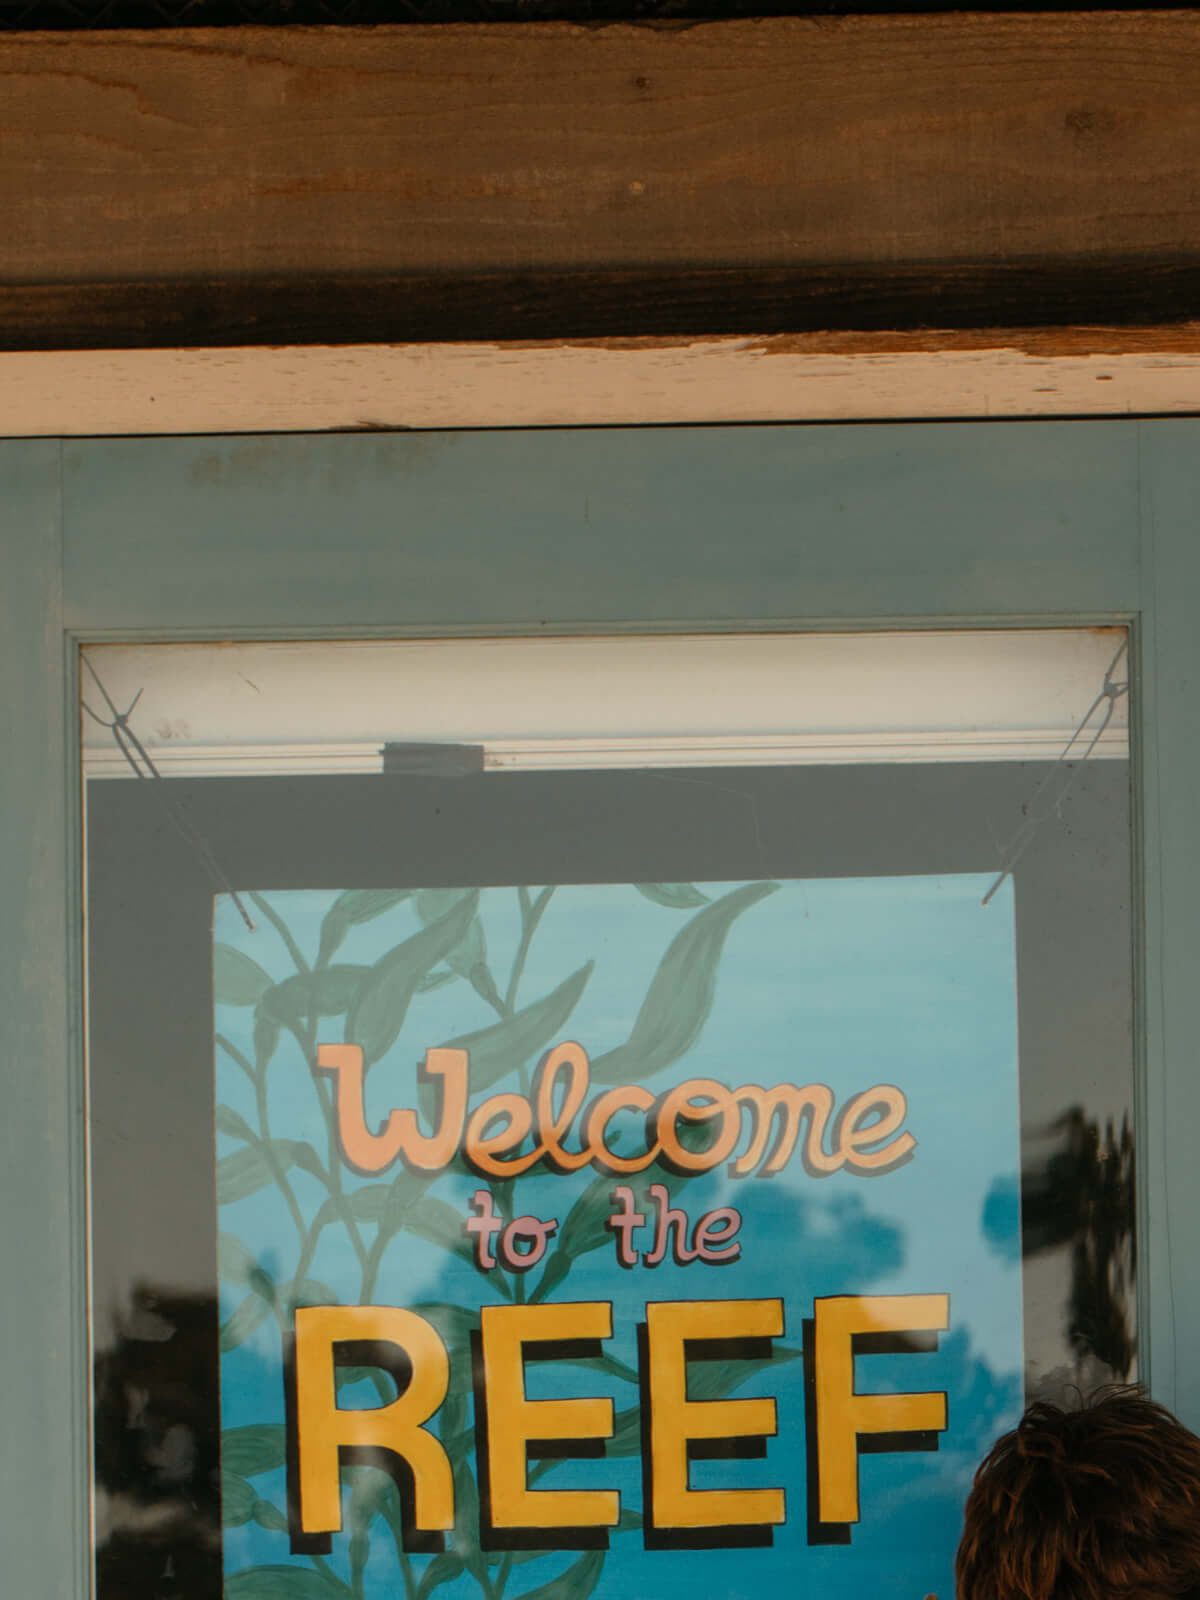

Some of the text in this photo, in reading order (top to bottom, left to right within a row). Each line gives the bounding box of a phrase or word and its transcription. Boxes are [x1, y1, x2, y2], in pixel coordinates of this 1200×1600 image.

[316, 1041, 918, 1178] Welcome
[465, 1184, 743, 1272] to the
[285, 1293, 950, 1553] REEF
